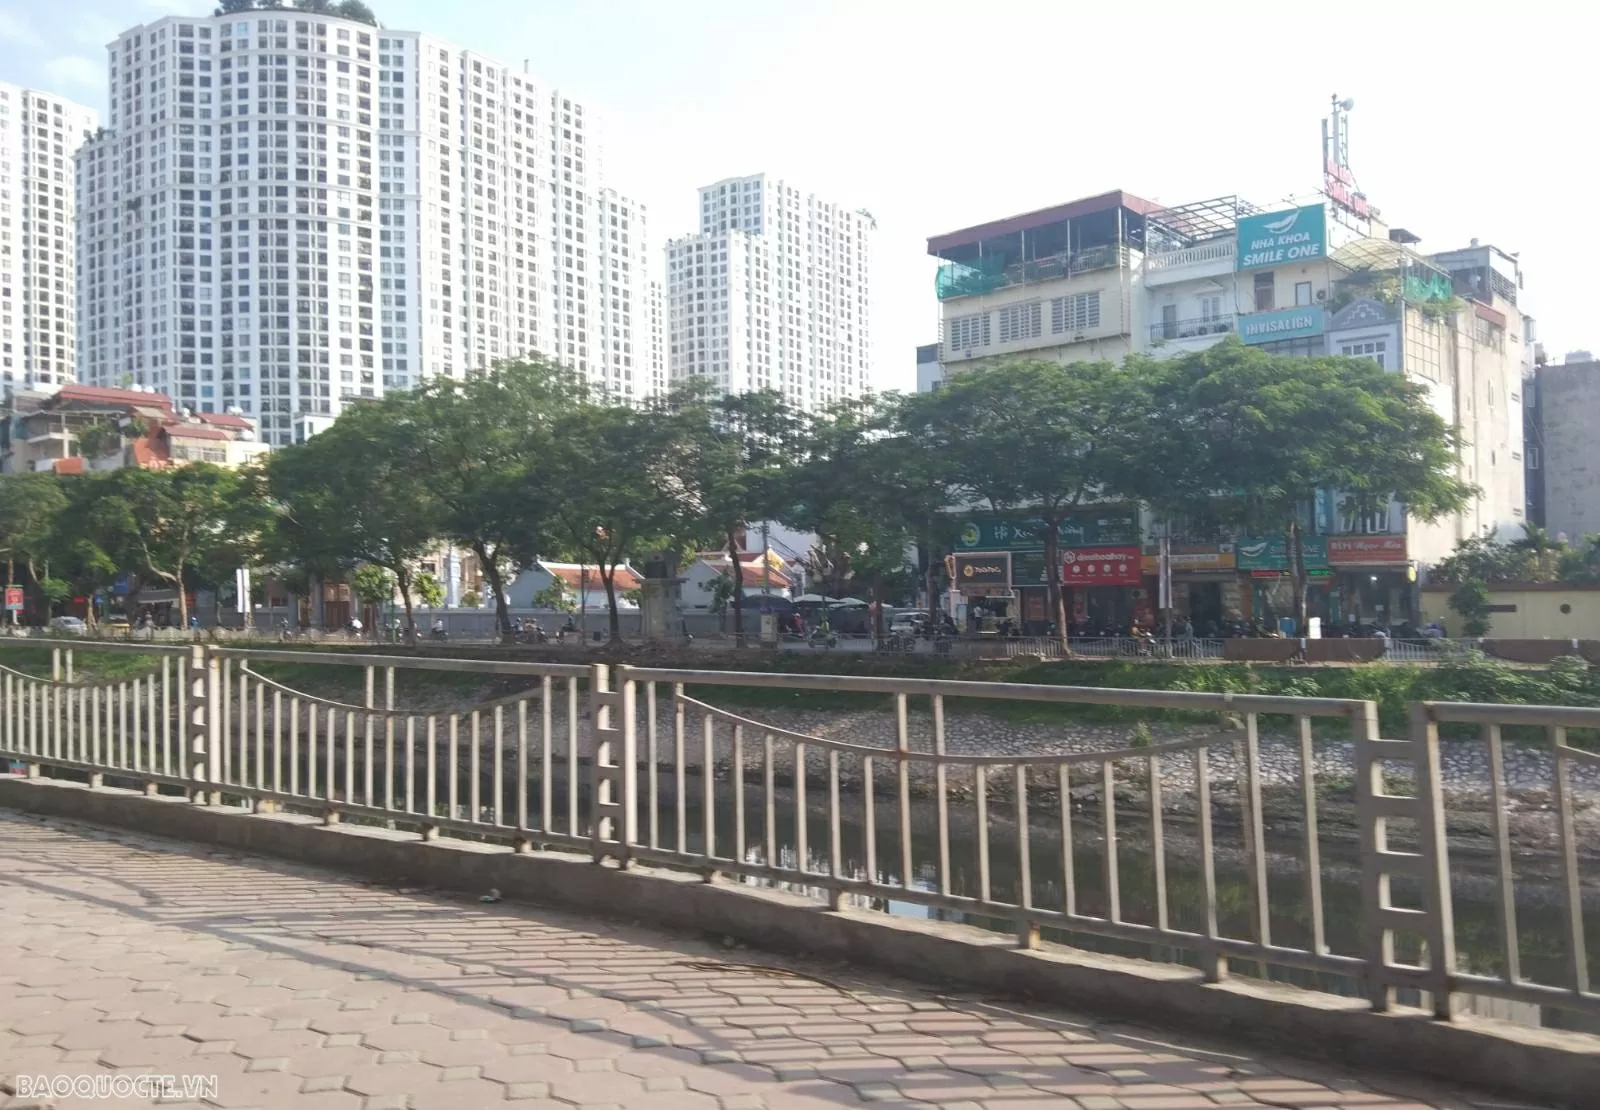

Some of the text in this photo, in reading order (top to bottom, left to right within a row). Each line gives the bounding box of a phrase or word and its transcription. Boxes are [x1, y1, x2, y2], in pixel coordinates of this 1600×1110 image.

[1251, 232, 1310, 250] NHA KHOA
[1243, 243, 1320, 266] SMILE ONE
[1246, 315, 1313, 335] INVISALIGN
